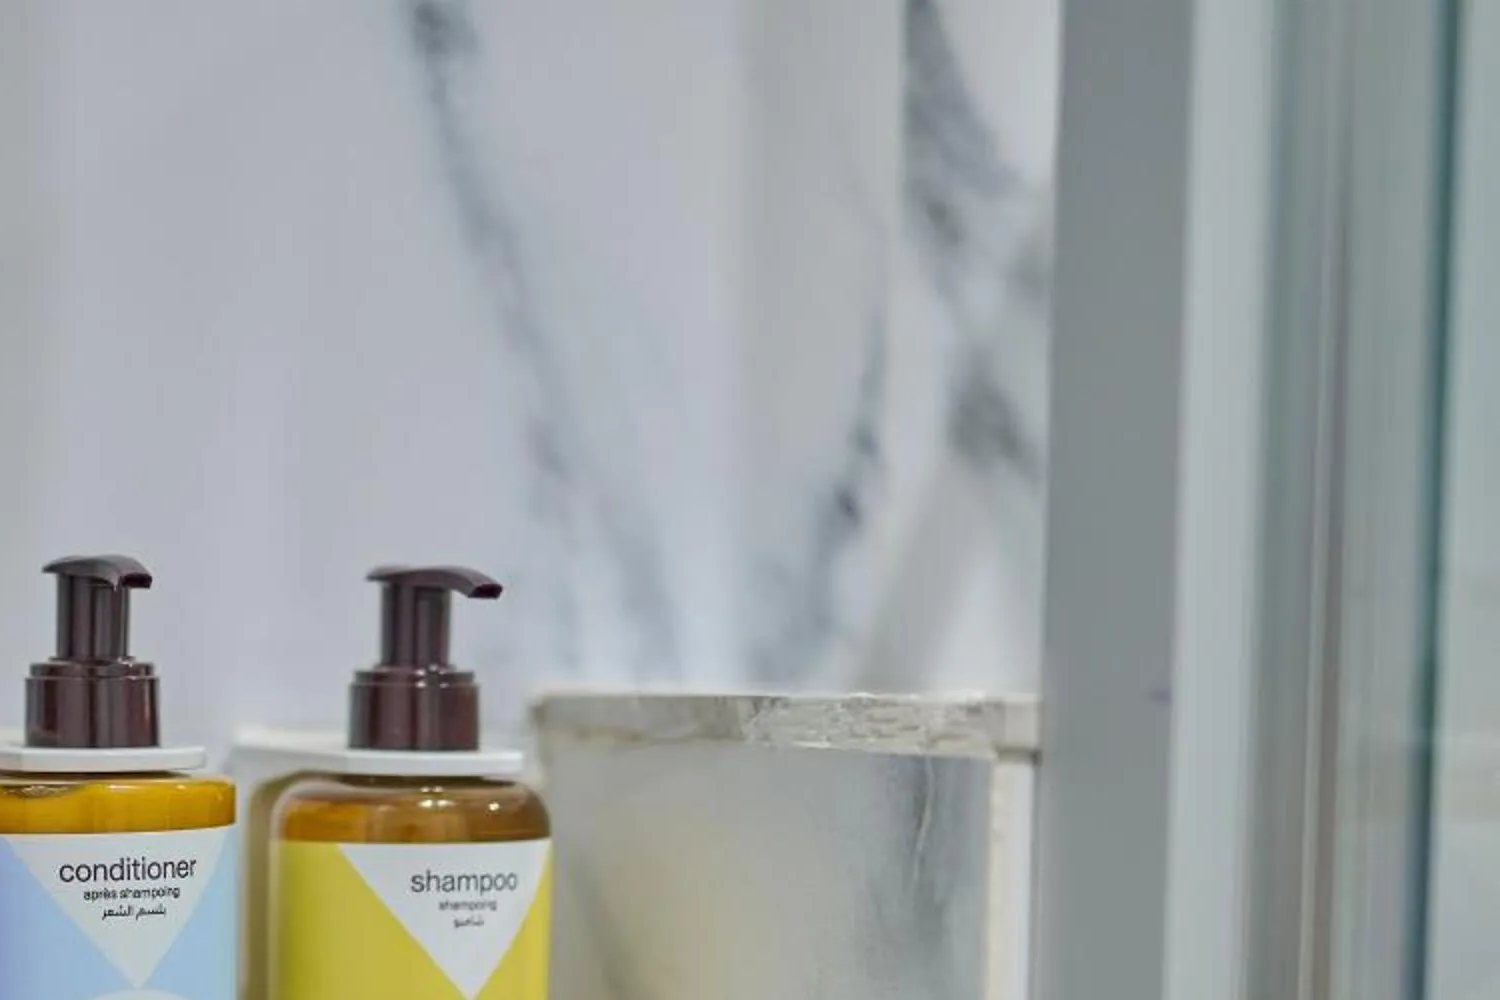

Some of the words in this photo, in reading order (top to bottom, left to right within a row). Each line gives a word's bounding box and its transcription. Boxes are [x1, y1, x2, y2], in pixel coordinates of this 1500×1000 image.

[59, 856, 197, 883] conditioner
[410, 869, 518, 897] shampoo
[83, 888, 117, 902] après
[119, 886, 181, 900] shampoing
